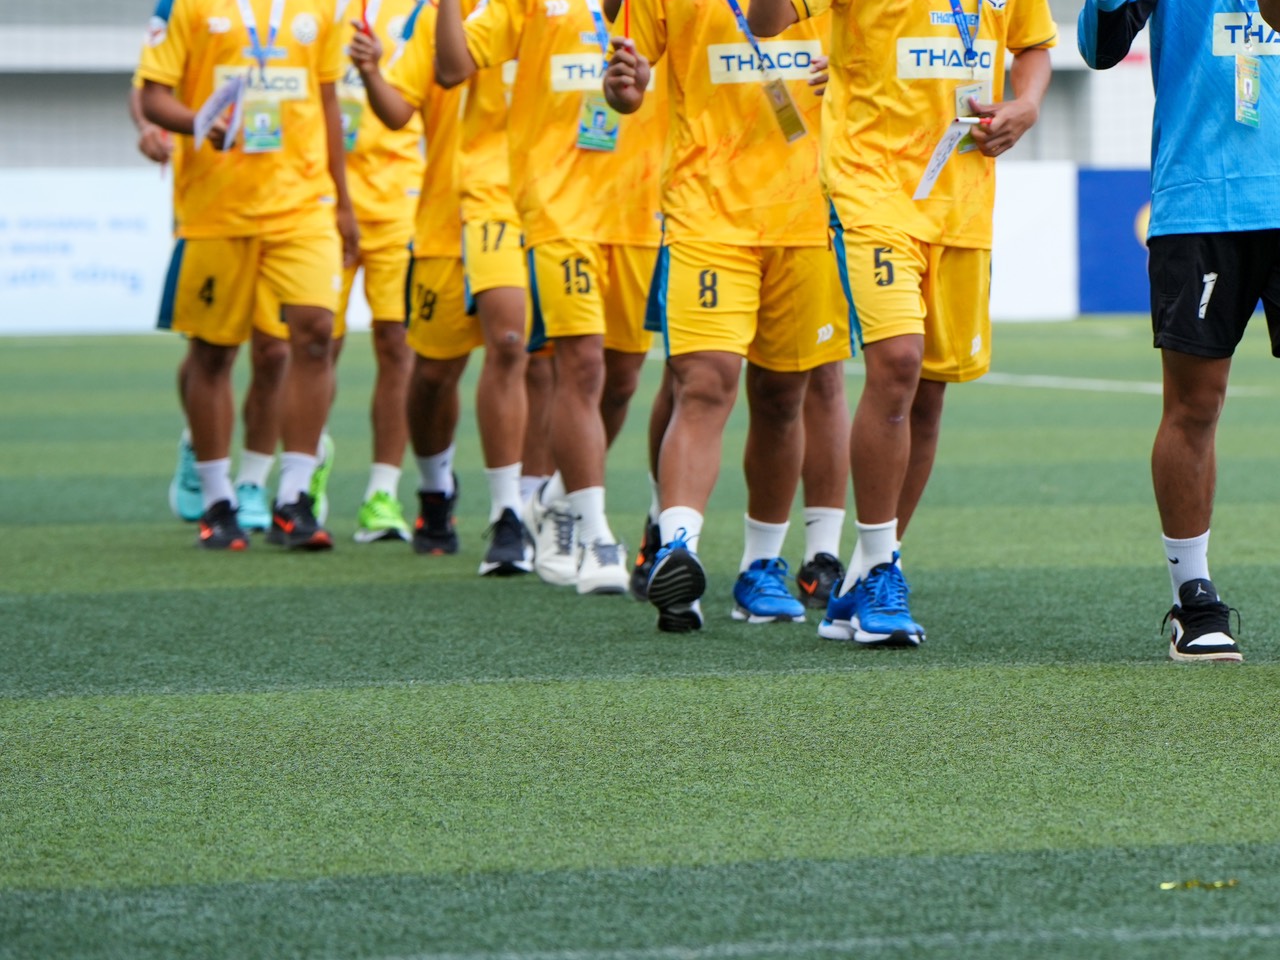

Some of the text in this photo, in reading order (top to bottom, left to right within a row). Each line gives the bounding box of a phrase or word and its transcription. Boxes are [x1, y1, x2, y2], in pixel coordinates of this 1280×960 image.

[719, 52, 811, 72] THACO
[481, 220, 507, 254] 17
[560, 257, 591, 296] 15
[872, 246, 895, 288] 5
[198, 275, 215, 308] 4
[698, 269, 718, 309] 8
[1197, 272, 1219, 320] 1
